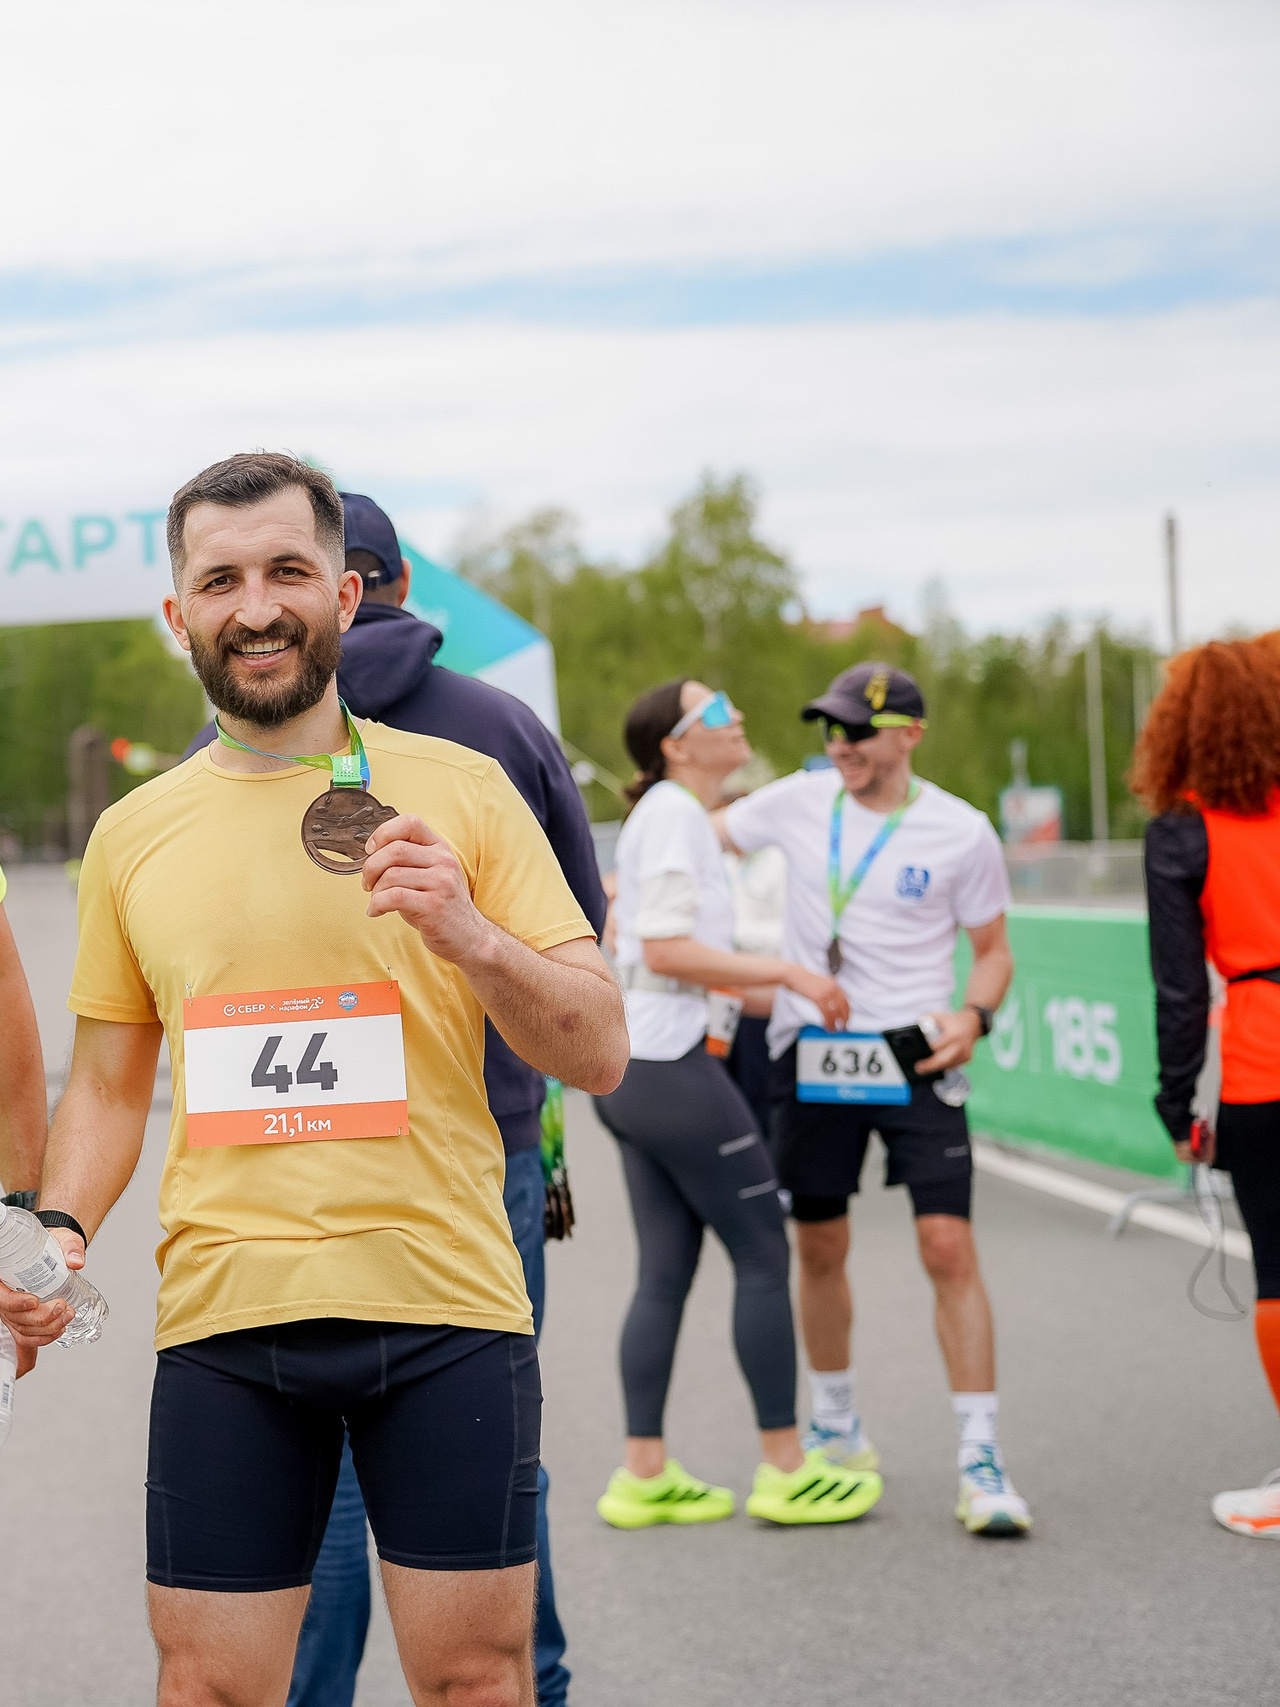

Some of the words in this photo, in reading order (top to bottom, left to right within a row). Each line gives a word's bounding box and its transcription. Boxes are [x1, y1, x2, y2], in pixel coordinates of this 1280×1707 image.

[237, 1003, 266, 1014] СБЕР
[278, 1004, 308, 1013] марафон
[1045, 997, 1122, 1085] 185
[250, 1032, 339, 1093] 44
[821, 1049, 883, 1076] 636
